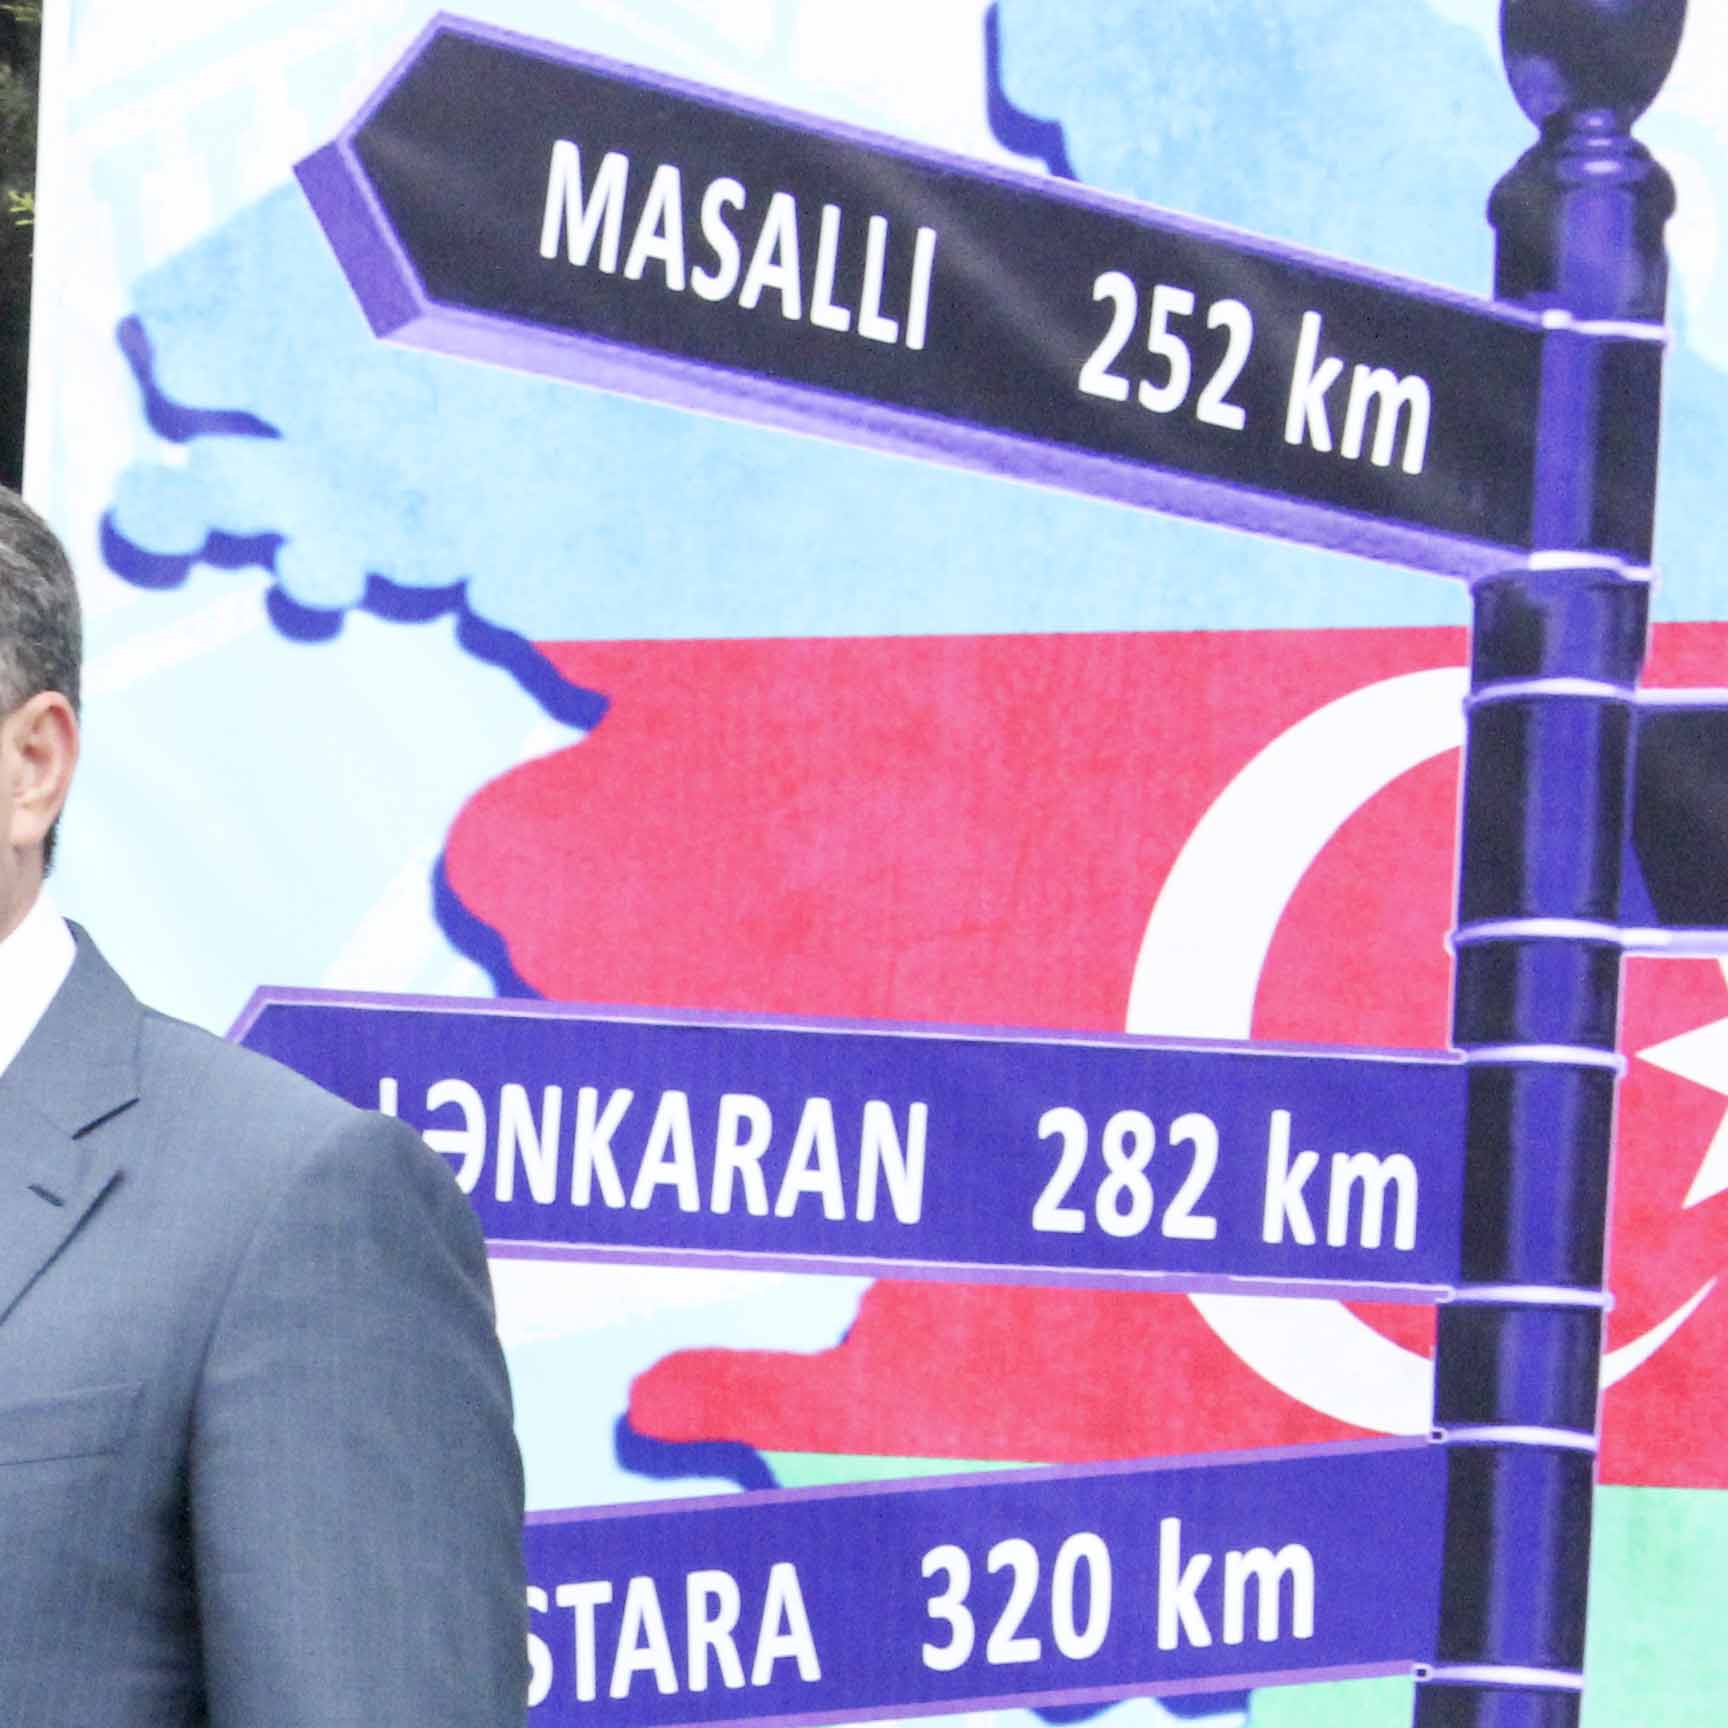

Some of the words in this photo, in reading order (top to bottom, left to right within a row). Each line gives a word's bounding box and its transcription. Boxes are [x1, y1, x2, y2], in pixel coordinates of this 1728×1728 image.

[539, 138, 938, 351] MASALLI
[1077, 270, 1254, 431] 252
[1283, 310, 1431, 476] km
[1031, 1105, 1220, 1241] 282
[1261, 1108, 1419, 1252] km
[920, 1531, 1113, 1672] 320
[1156, 1516, 1316, 1652] km
